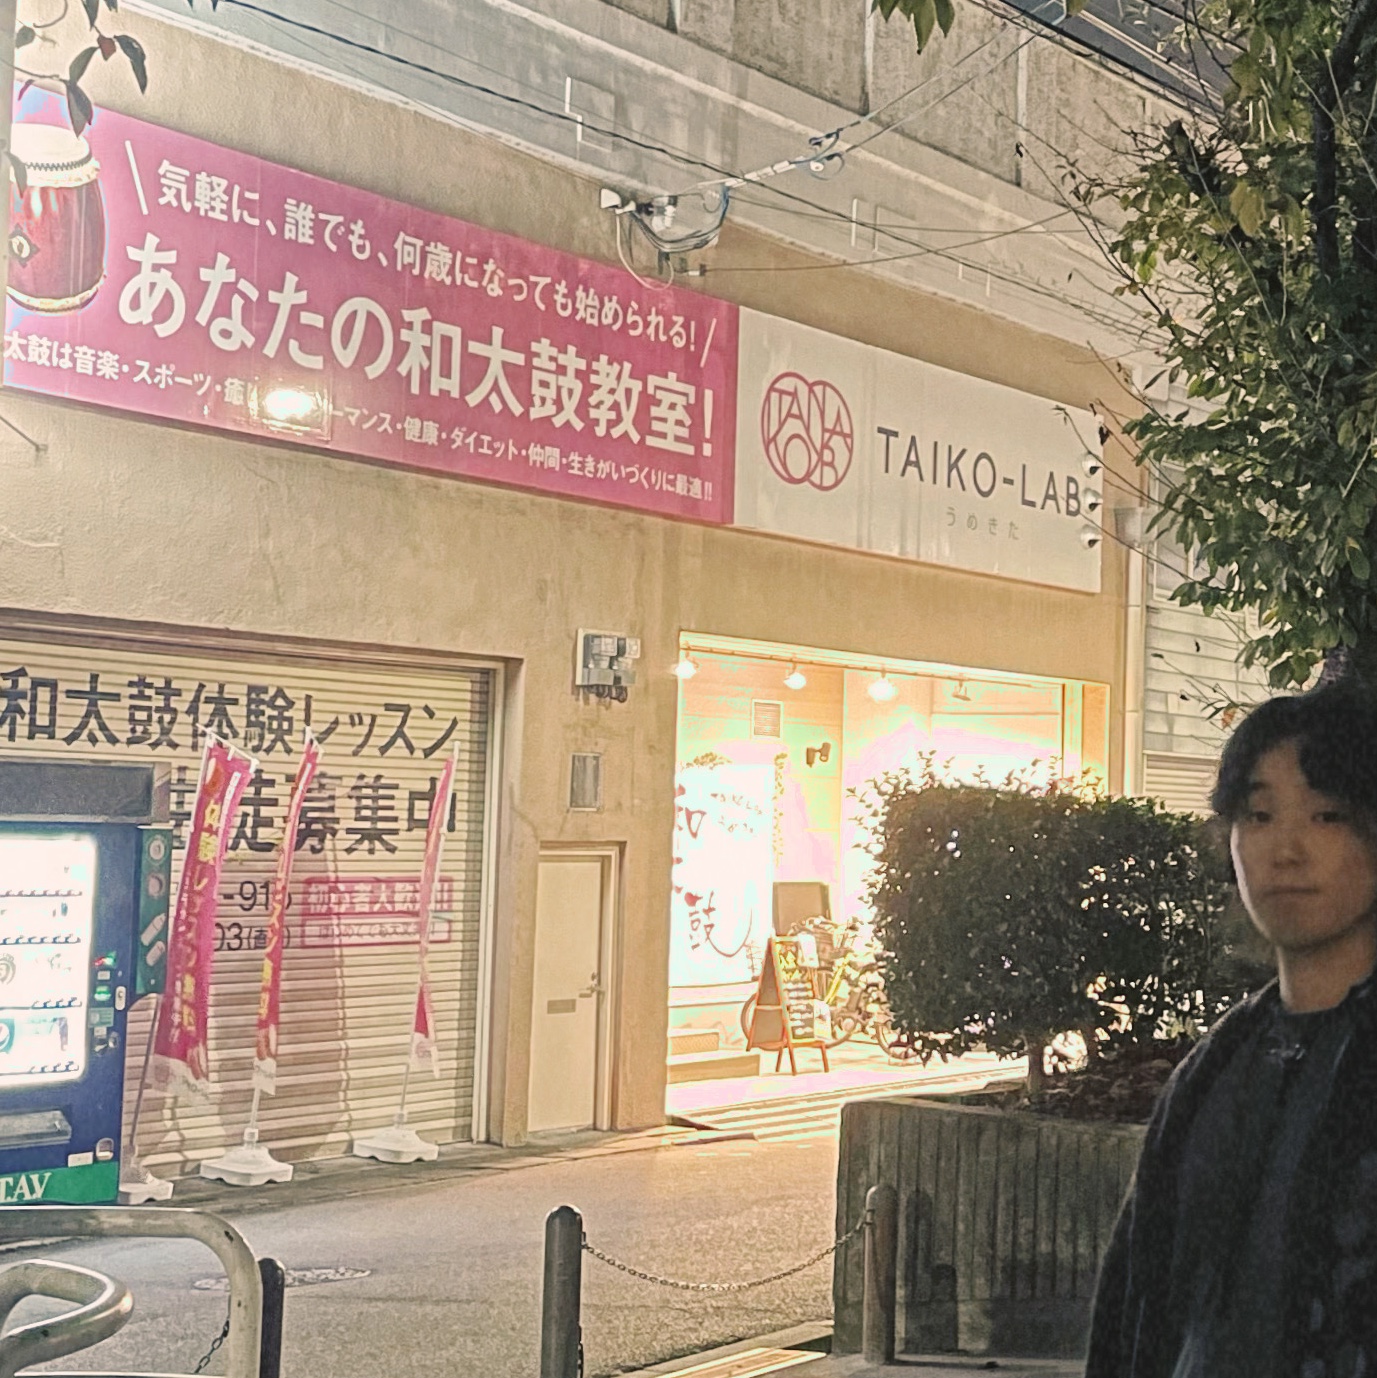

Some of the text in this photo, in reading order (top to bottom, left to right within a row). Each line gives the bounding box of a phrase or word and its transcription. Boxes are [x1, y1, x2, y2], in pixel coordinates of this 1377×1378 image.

[157, 159, 696, 352] 気軽に、誰でも、何歳になっても始められる!
[118, 232, 713, 458] あなたの和太鼓教室!
[876, 426, 1082, 518] TAIKO-LAB
[946, 506, 1020, 541] うめきた
[0, 667, 459, 759] 和太鼓体験レッスン
